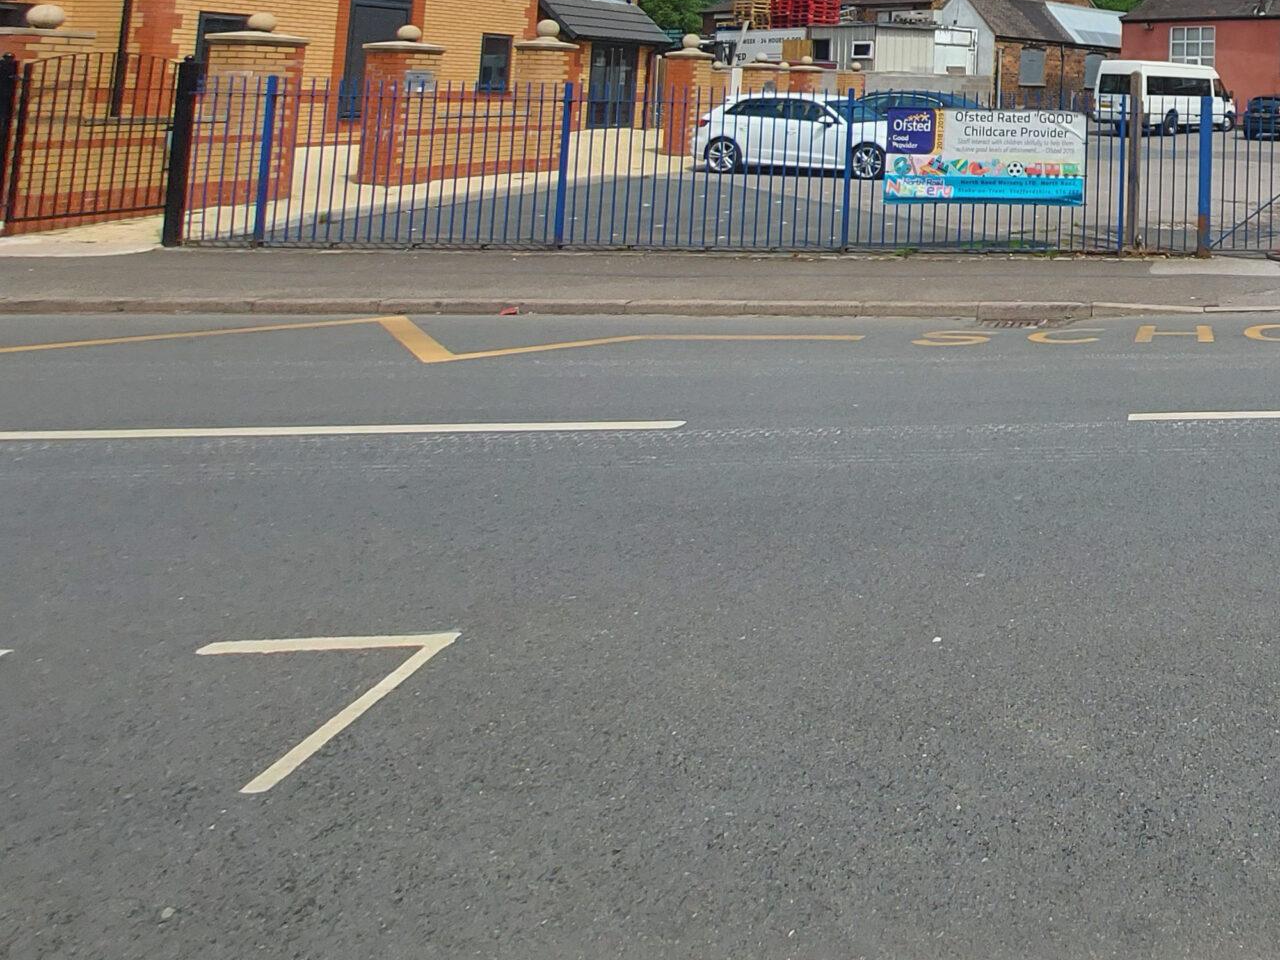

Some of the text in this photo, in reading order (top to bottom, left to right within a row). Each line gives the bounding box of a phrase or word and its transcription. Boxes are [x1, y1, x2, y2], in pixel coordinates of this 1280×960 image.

[955, 111, 994, 123] Ofsted
[997, 112, 1031, 124] Rated
[893, 118, 931, 132] Ofsted
[892, 134, 909, 142] Good
[963, 125, 1069, 139] Childcare Provider
[891, 141, 918, 149] Provider
